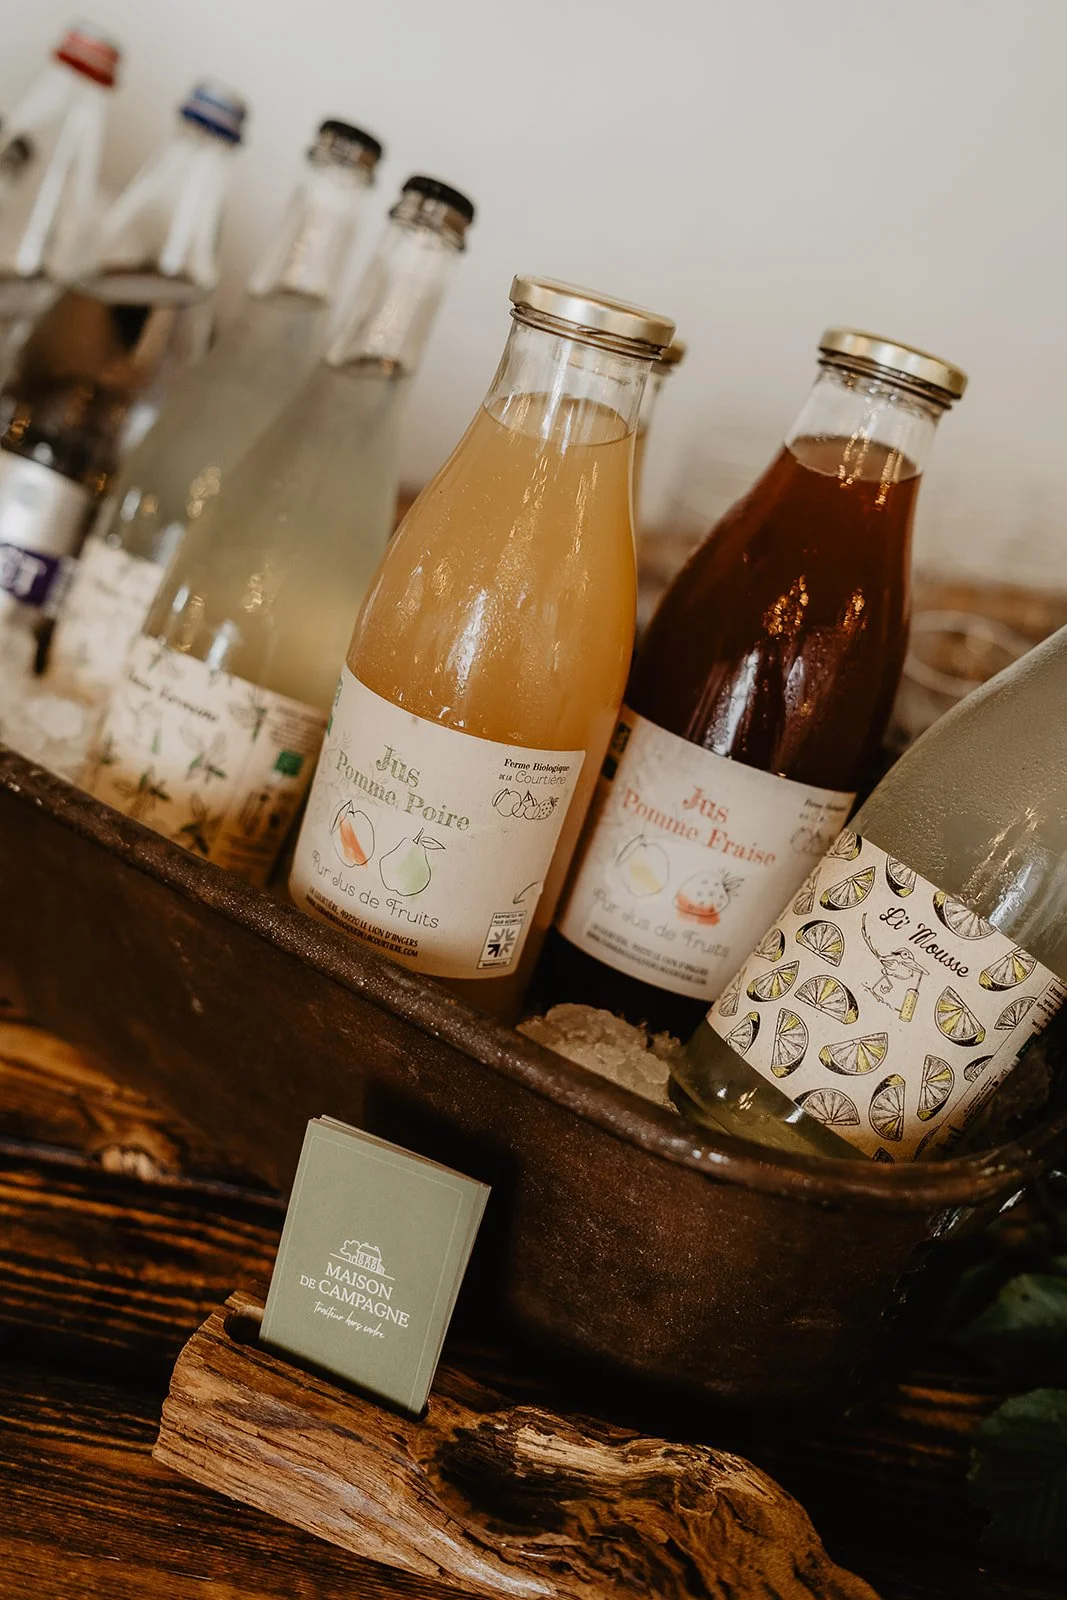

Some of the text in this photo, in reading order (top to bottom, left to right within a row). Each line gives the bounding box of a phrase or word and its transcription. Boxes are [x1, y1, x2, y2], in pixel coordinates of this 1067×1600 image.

[375, 744, 421, 788] Jus
[503, 758, 570, 773] Ferme Biologique
[516, 770, 567, 785] Courtière
[335, 750, 471, 831] Pomme Poire
[682, 784, 730, 824] Jus
[622, 789, 777, 867] Pomme Fraise
[311, 849, 439, 929] Pur Jus de Fruits
[340, 909, 360, 926] 49220
[368, 924, 385, 938] LION
[385, 931, 418, 947] D'ANGERS
[654, 923, 676, 941] de
[682, 929, 730, 958] Fruits
[909, 922, 971, 979] Mousse
[300, 1274, 410, 1328] DE CAMPAGNE
[325, 1262, 393, 1300] MAISON
